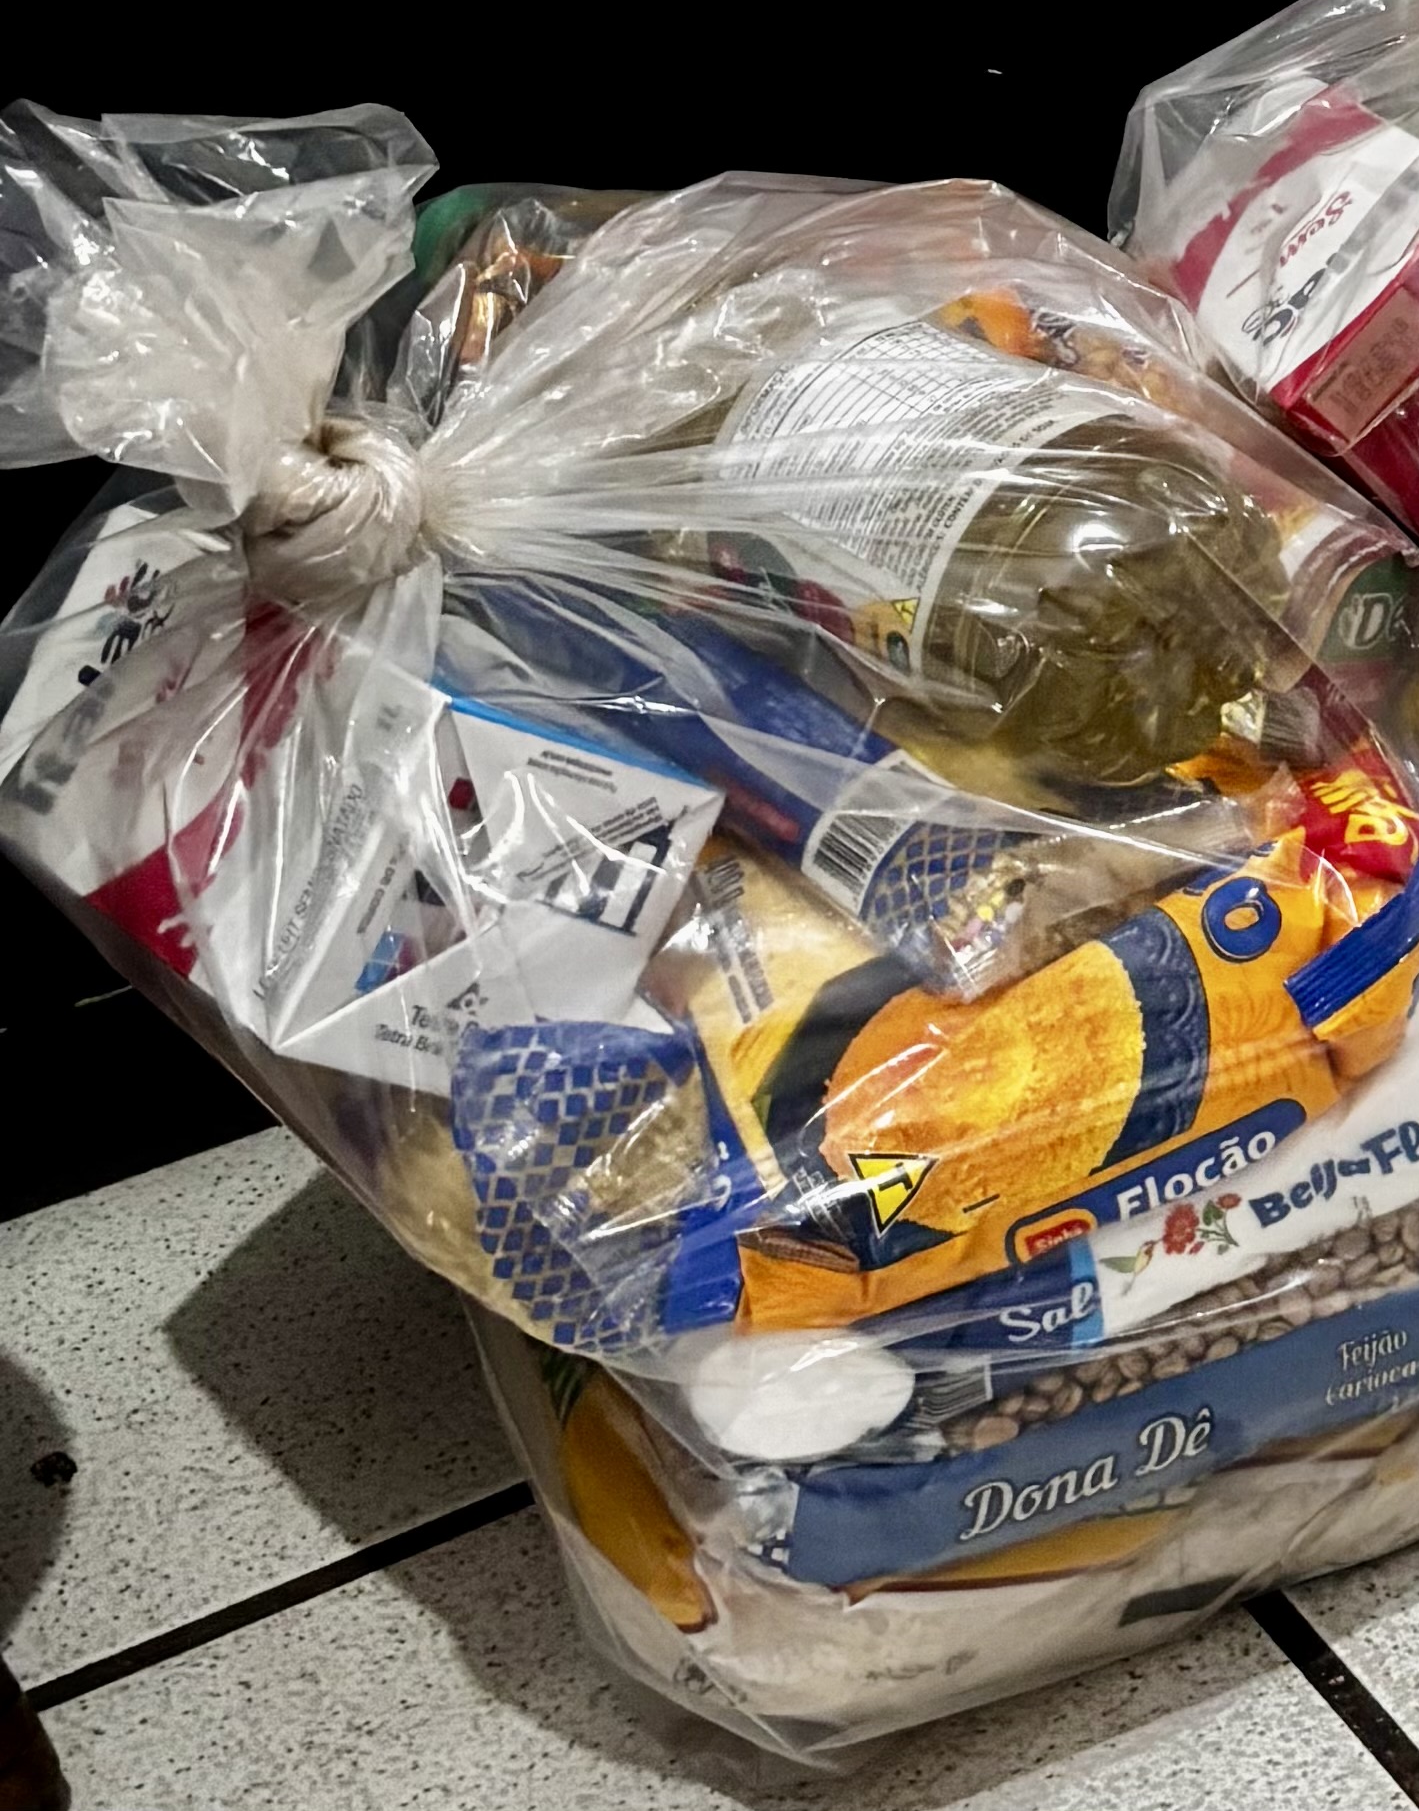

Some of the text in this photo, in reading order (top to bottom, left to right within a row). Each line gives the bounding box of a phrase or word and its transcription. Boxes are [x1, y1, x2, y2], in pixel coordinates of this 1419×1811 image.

[1116, 1129, 1278, 1224] Flocão
[999, 1281, 1098, 1343] Sal
[1335, 1327, 1410, 1373] Feijão
[960, 1407, 1215, 1542] Dona Dê
